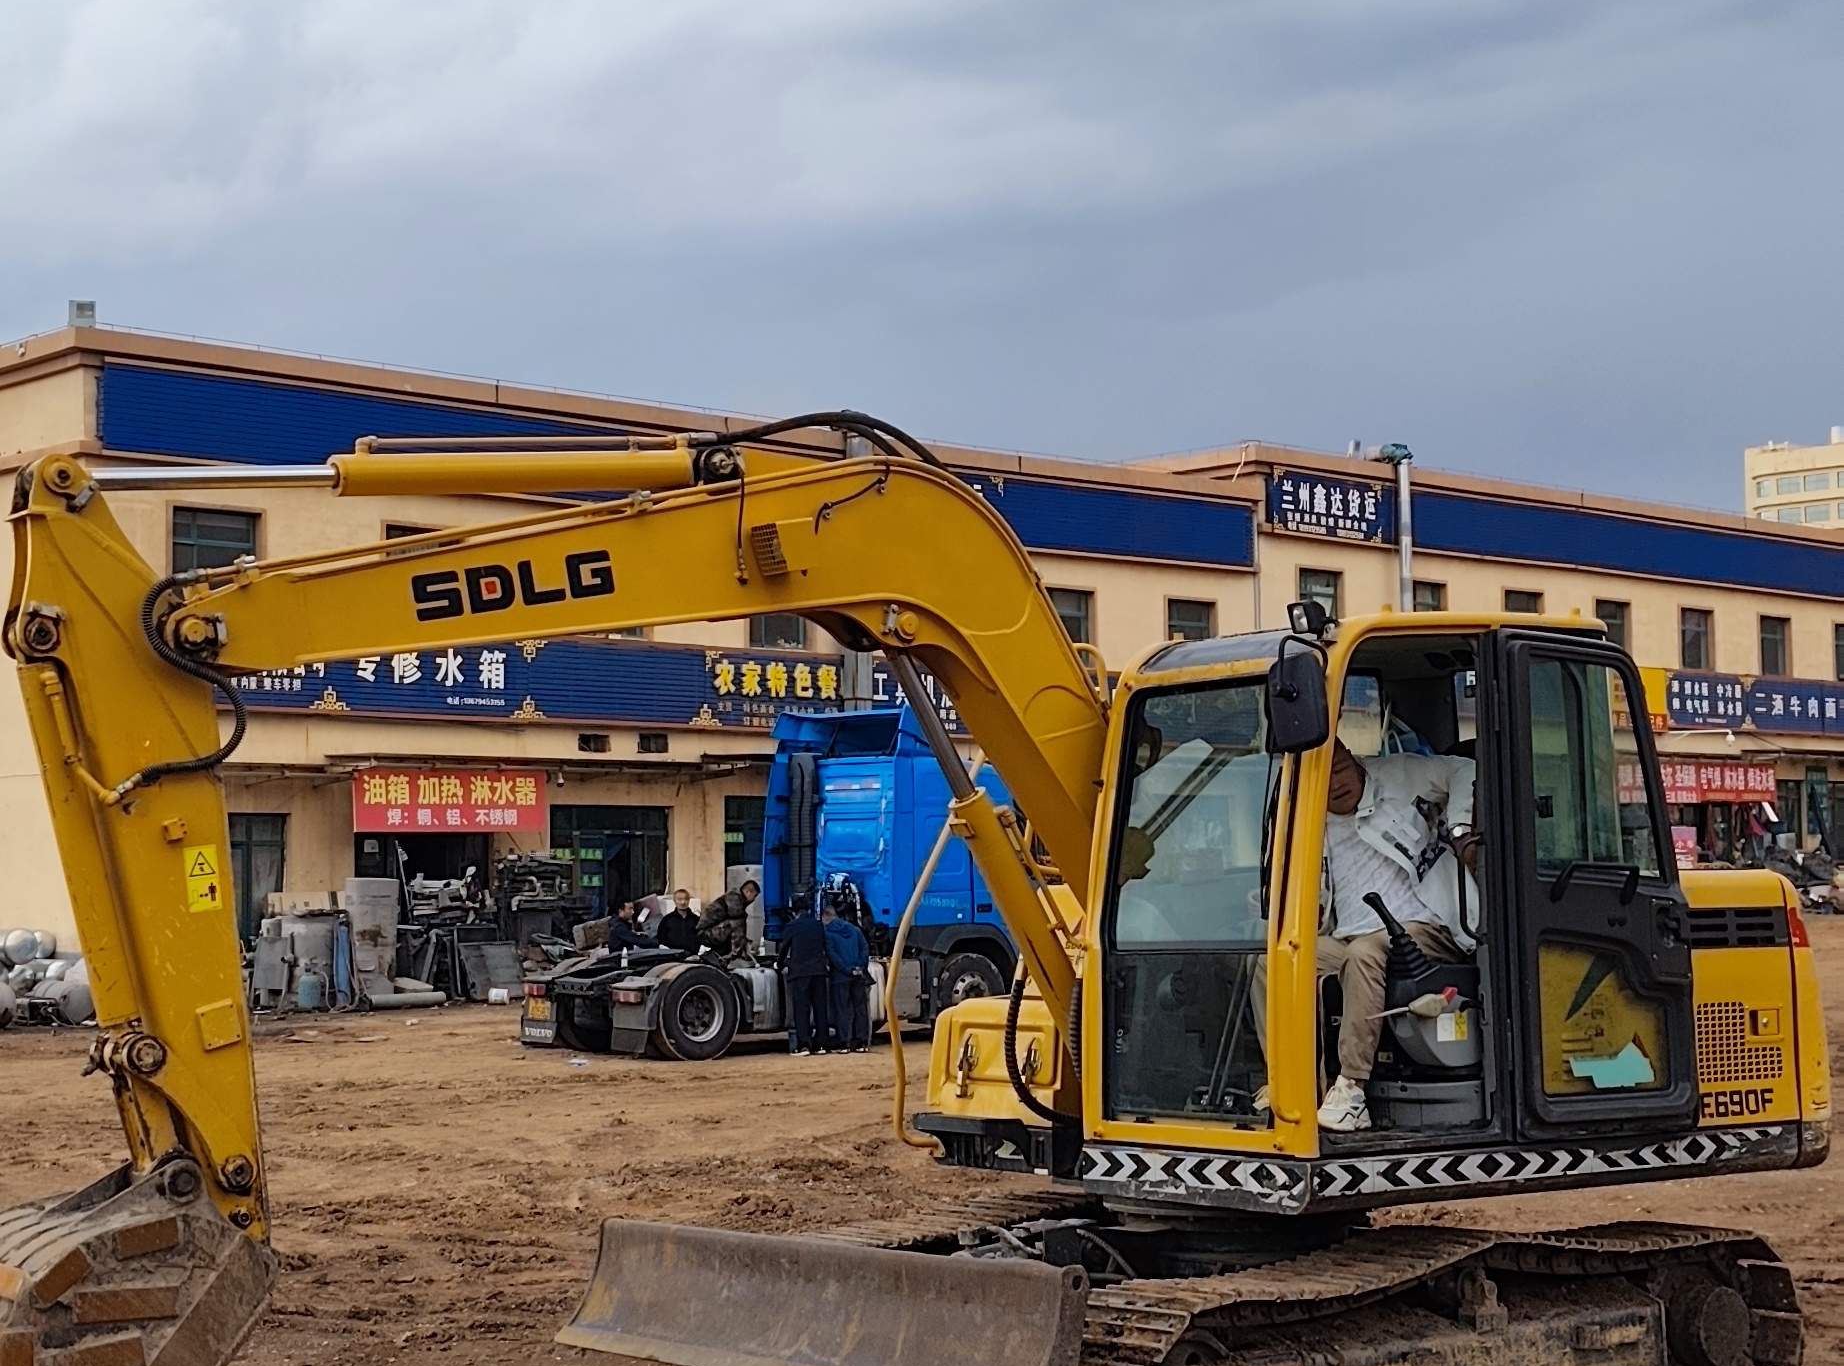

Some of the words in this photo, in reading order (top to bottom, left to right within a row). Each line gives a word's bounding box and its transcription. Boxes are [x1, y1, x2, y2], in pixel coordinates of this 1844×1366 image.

[1281, 479, 1377, 520] 兰州鑫达货运
[411, 549, 615, 622] SDLG
[356, 648, 507, 690] 专修水箱
[713, 659, 838, 701] 农家特色餐
[363, 774, 410, 805] 油箱
[417, 774, 463, 805] 加热
[470, 775, 537, 806] 淋水器
[524, 1026, 553, 1038] VOLVO
[1700, 1088, 1775, 1119] E690F
